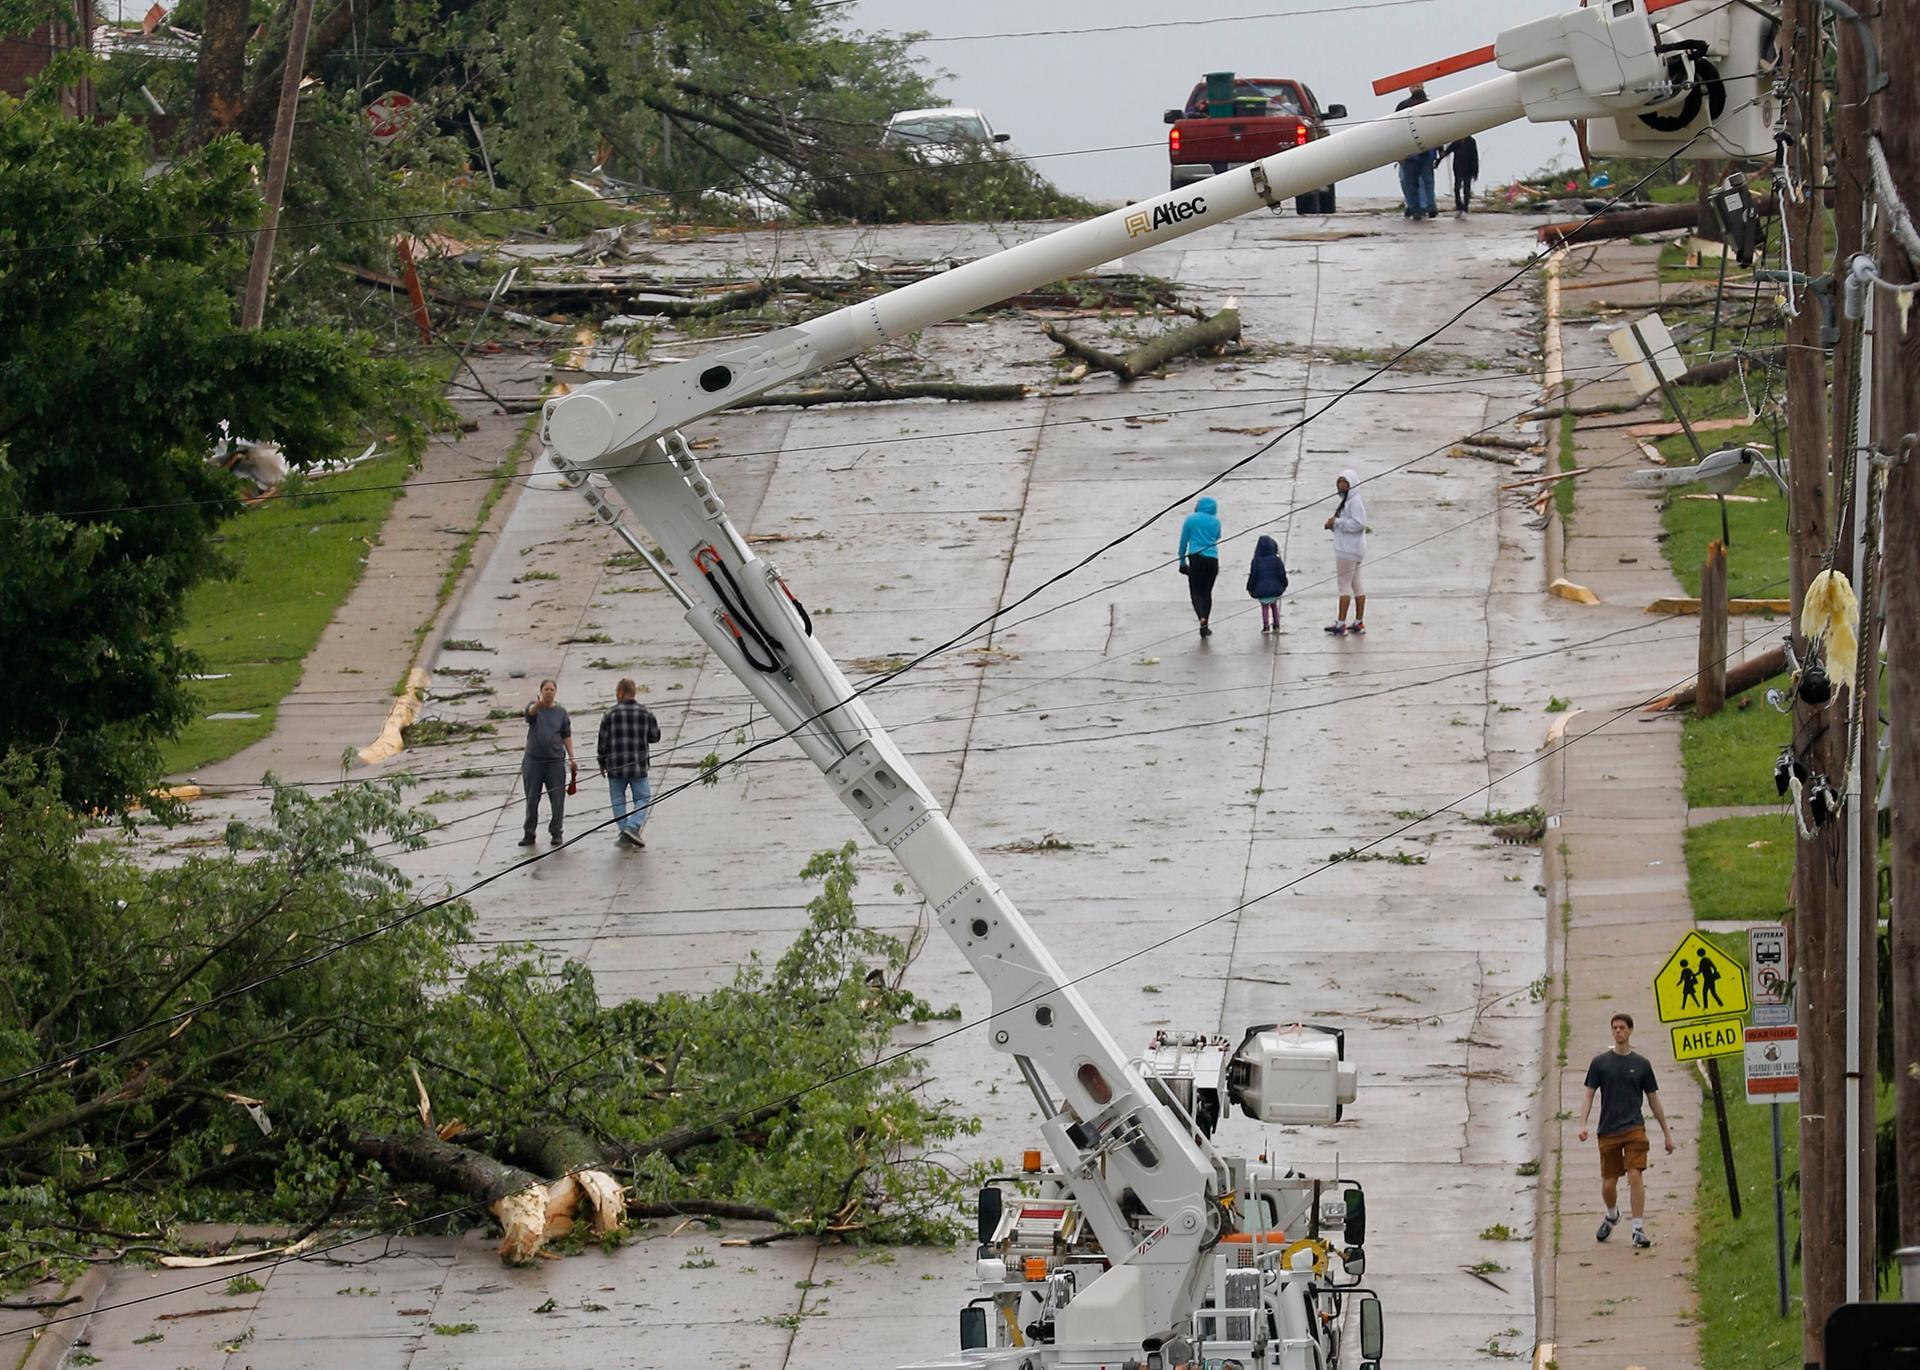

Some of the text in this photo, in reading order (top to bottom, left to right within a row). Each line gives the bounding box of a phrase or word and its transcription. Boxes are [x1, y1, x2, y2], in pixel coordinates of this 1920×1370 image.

[1153, 196, 1207, 230] Altec
[1683, 1028, 1736, 1051] AHEAD
[1748, 1029, 1796, 1039] WARNING
